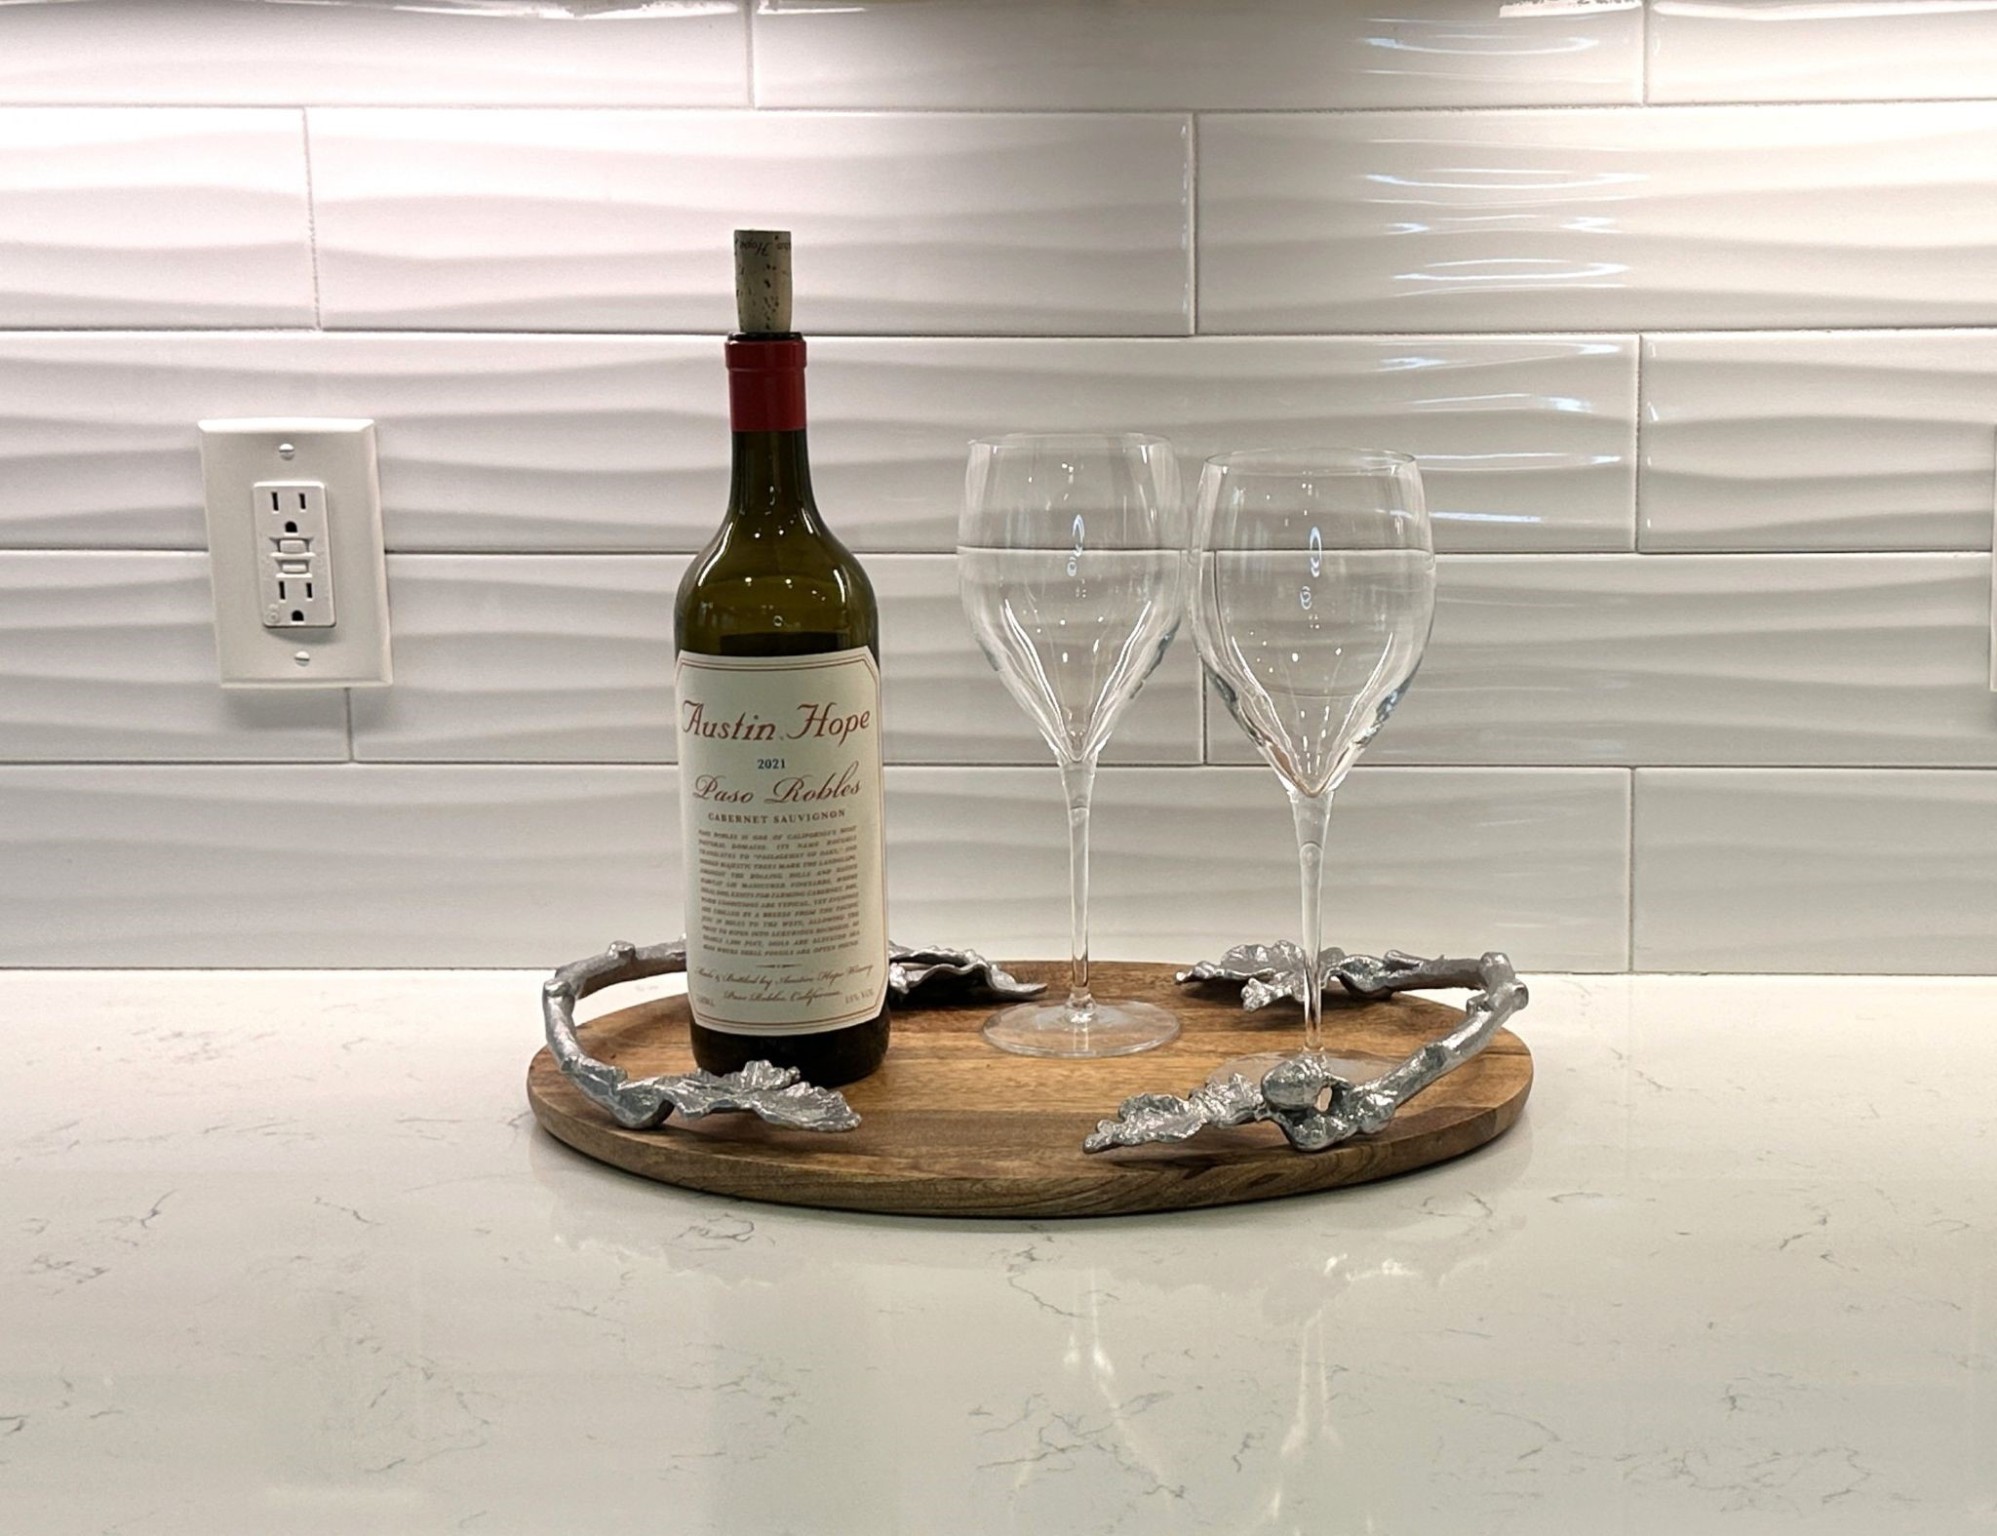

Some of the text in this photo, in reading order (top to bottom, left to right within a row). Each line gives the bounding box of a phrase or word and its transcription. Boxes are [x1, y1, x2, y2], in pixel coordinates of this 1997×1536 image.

[683, 700, 871, 747] Austin Hope
[757, 758, 786, 769] 2021
[693, 760, 862, 804] Paso Robles
[707, 809, 846, 824] CABERNET SAUVIGNON
